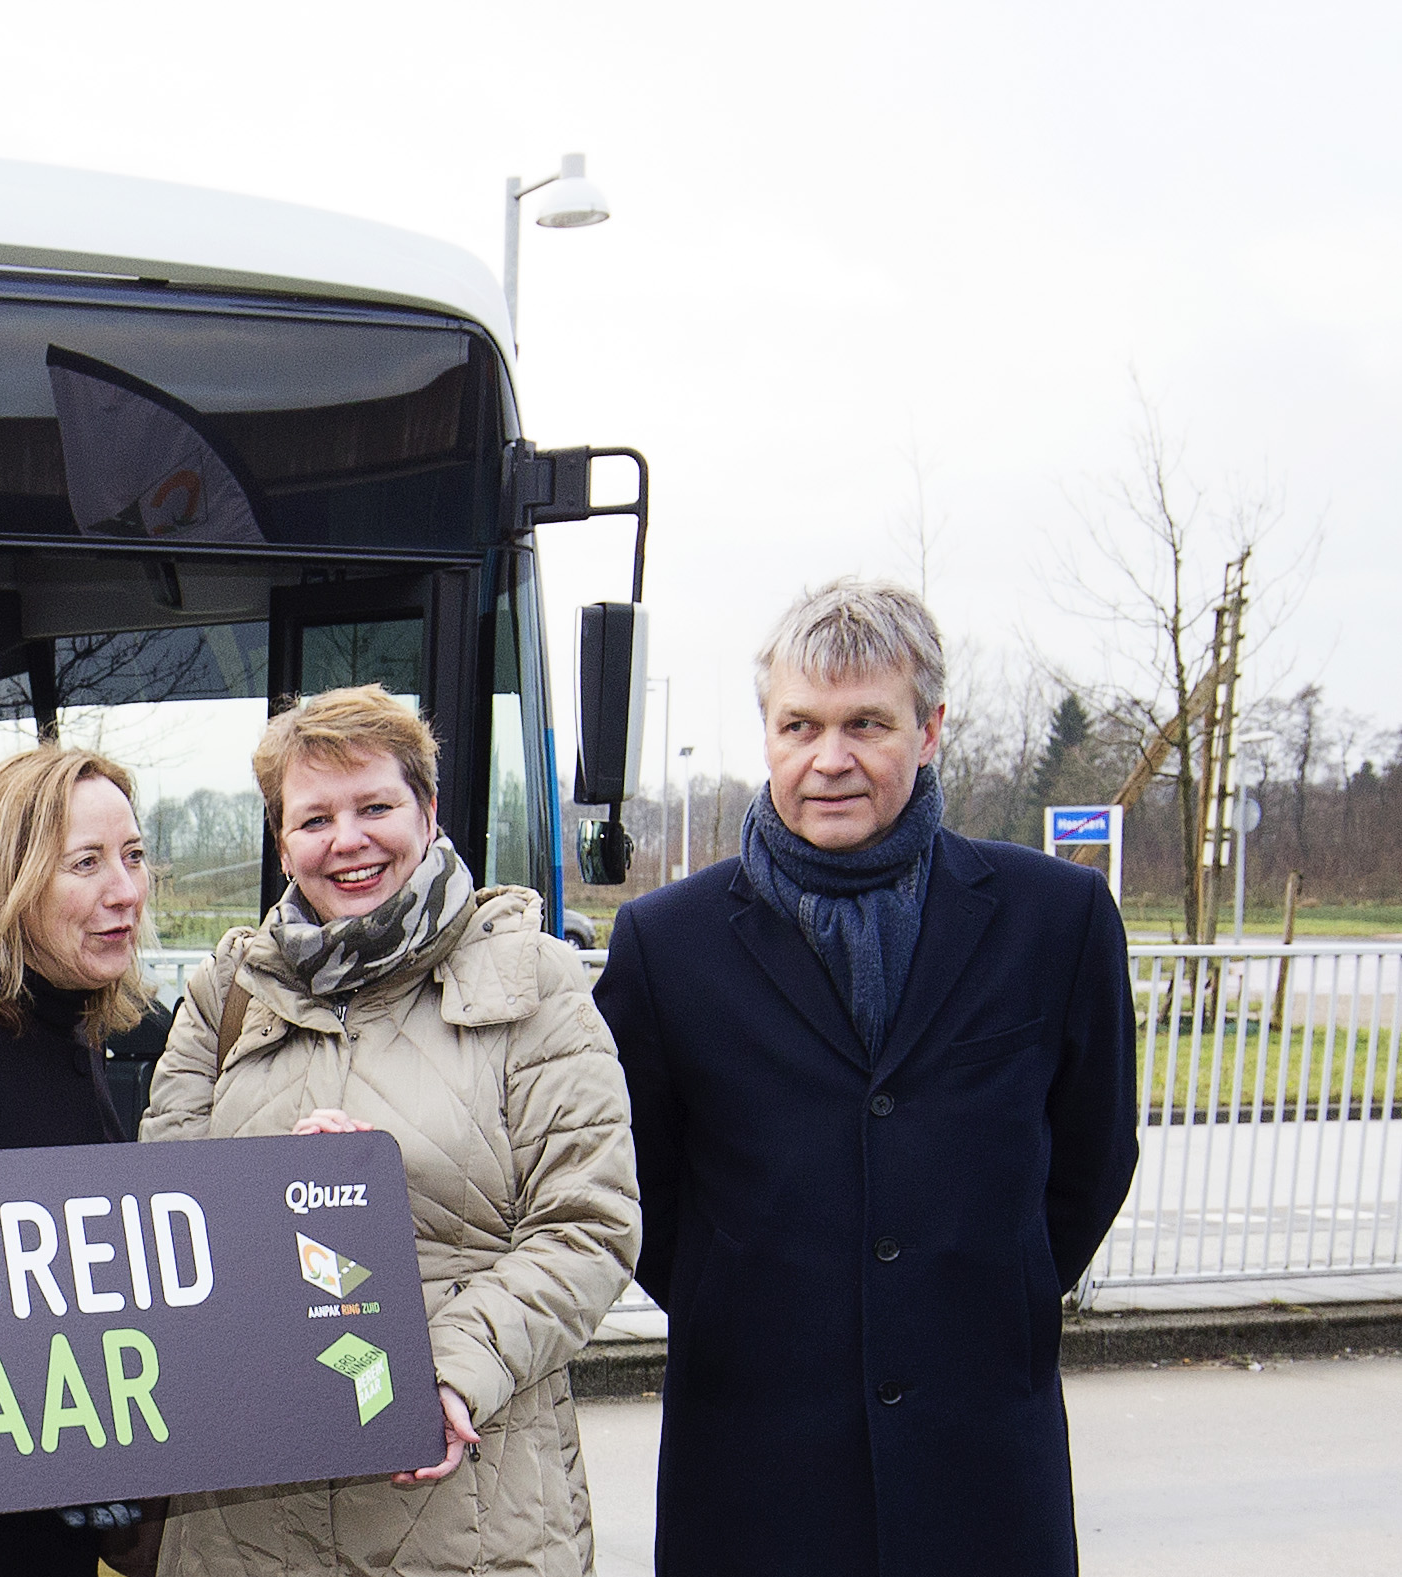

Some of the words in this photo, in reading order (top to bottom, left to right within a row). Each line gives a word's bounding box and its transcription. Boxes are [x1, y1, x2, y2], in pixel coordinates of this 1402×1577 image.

[285, 1181, 368, 1214] Qbuzz
[308, 1304, 341, 1318] AANPAK
[341, 1302, 361, 1316] RING
[362, 1301, 381, 1314] ZUID
[333, 1353, 357, 1372] GRO
[357, 1379, 383, 1407] BAAR
